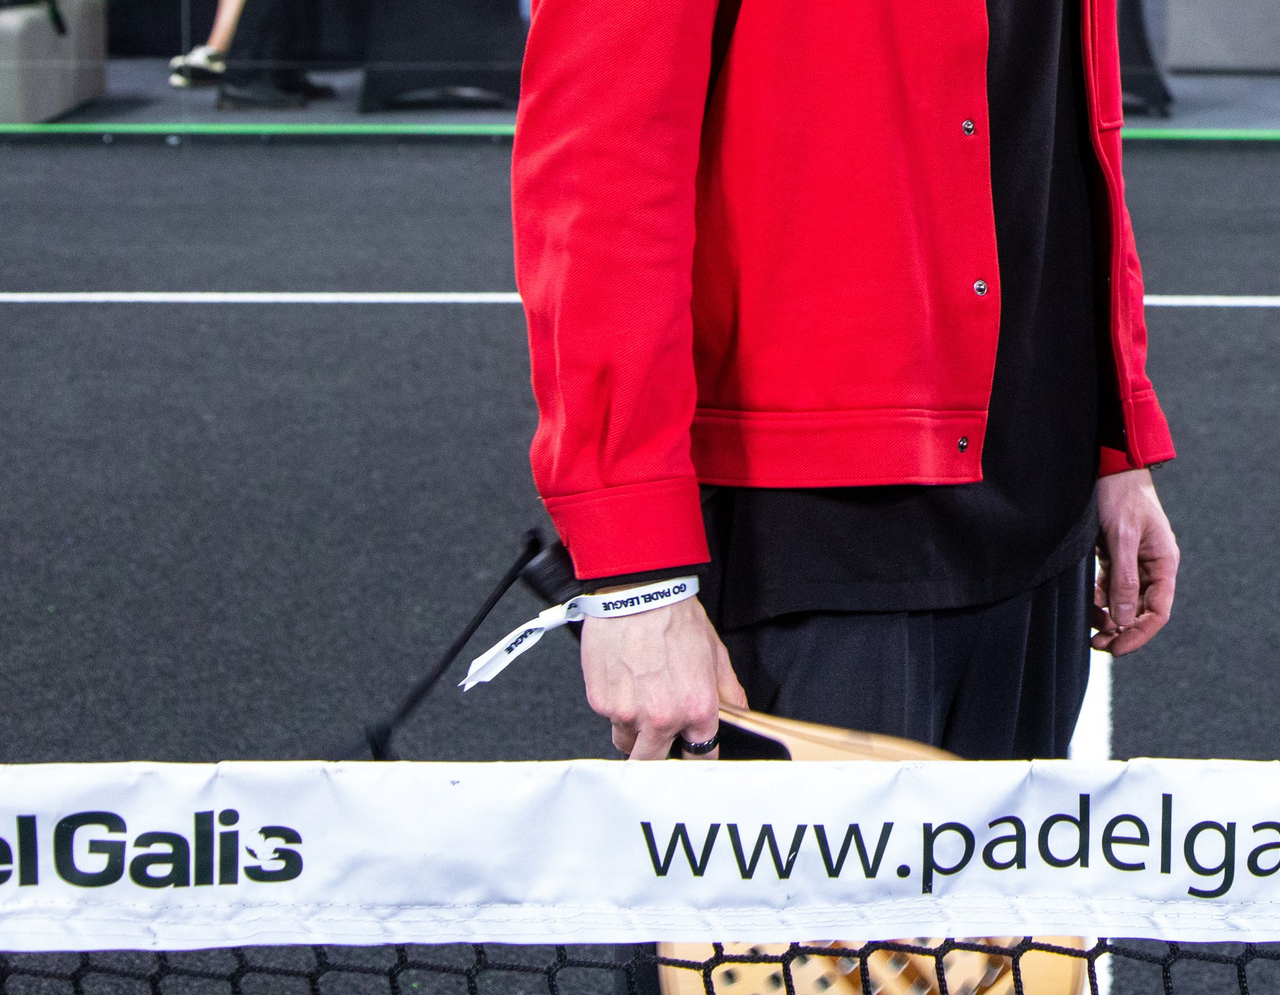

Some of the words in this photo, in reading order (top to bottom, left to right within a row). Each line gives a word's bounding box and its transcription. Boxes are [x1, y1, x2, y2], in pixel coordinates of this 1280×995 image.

[643, 589, 672, 605] PADEL
[672, 583, 687, 595] GO
[602, 595, 641, 612] LEAGUE
[504, 626, 538, 655] EAGUE
